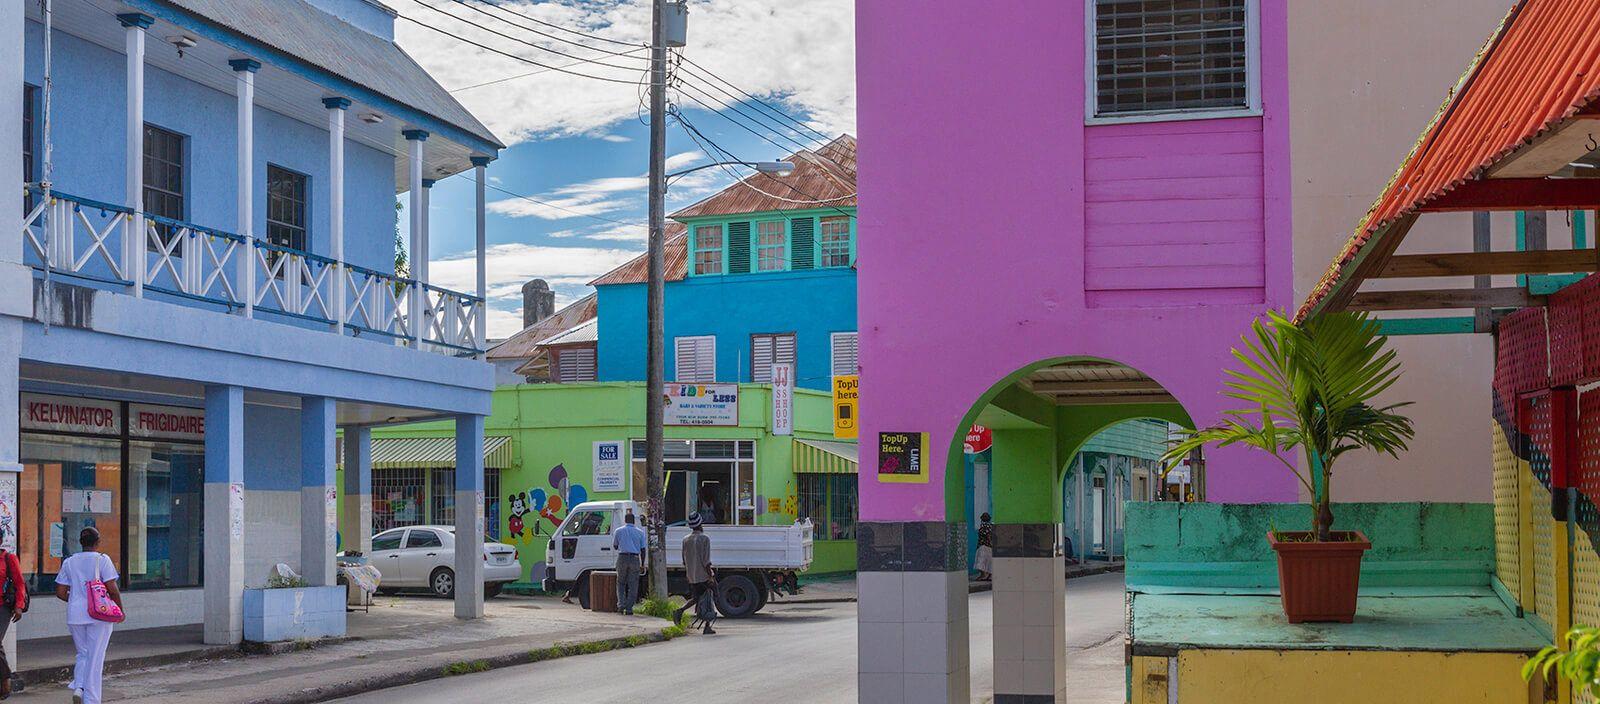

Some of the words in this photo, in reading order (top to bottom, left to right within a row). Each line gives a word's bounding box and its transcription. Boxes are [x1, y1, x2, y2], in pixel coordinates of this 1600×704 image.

[837, 380, 859, 390] TopU
[670, 385, 706, 398] KIDS
[713, 394, 736, 403] LESS
[29, 402, 113, 428] KELVINATOR
[139, 412, 205, 434] FRIGIDAIRE
[974, 424, 985, 432] Up
[881, 434, 908, 443] TopUp
[882, 444, 904, 453] Here.
[910, 448, 919, 471] LIME
